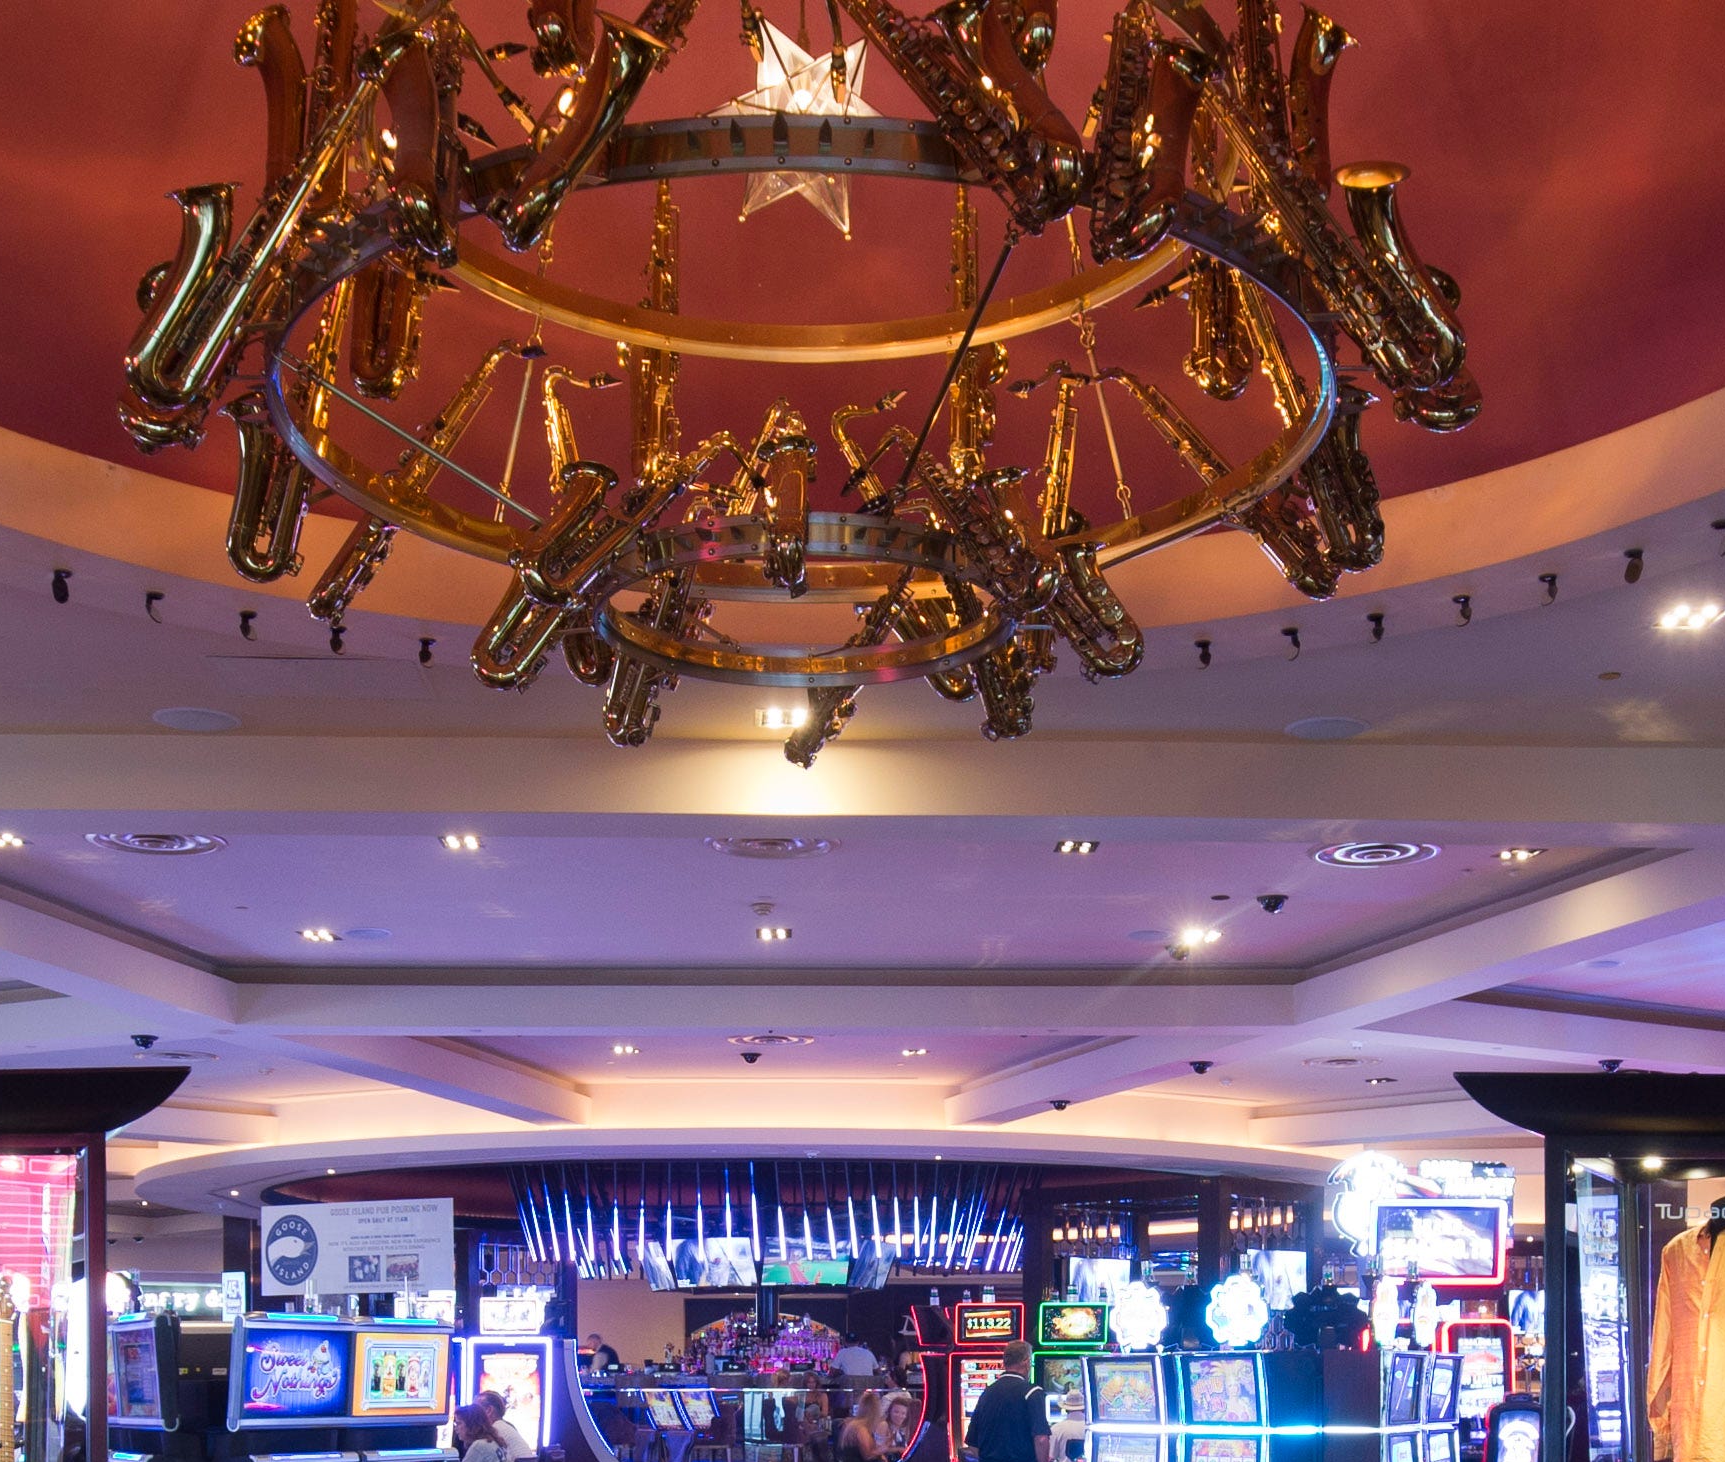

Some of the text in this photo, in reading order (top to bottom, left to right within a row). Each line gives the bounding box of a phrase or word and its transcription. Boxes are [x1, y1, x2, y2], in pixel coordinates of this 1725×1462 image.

[275, 1221, 308, 1237] GOOSE
[274, 1262, 310, 1280] ISLAND
[252, 1368, 340, 1400] Nothings
